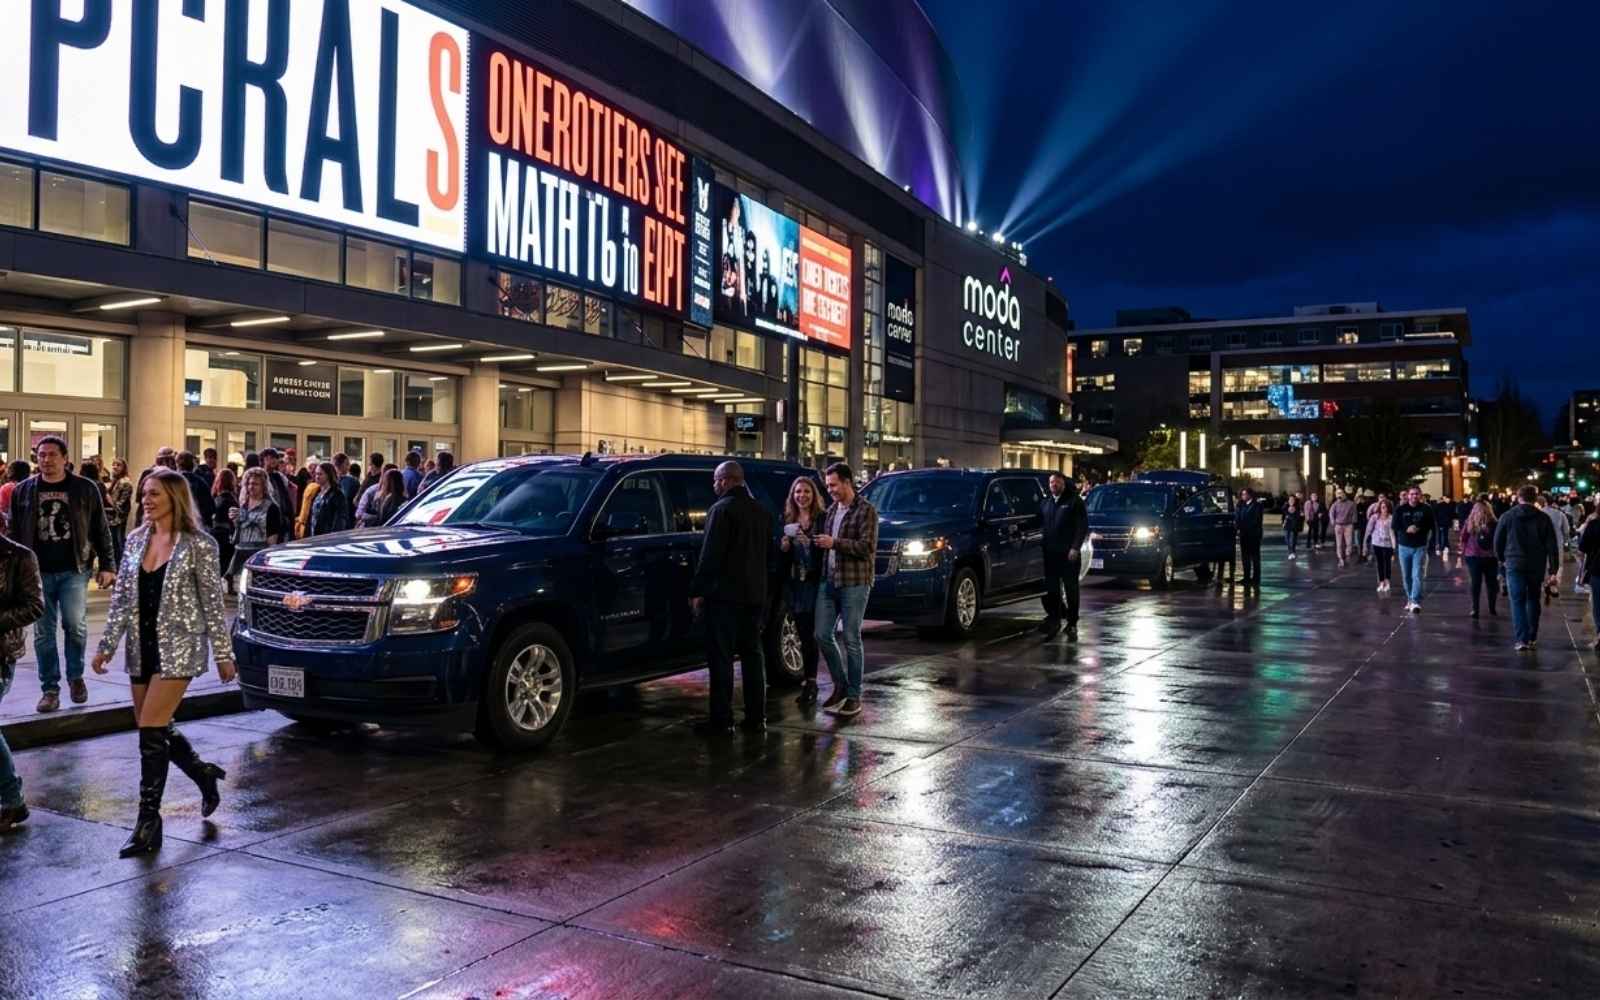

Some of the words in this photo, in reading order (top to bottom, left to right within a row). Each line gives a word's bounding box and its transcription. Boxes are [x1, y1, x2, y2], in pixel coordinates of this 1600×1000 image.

[489, 51, 650, 205] ONEROTIERS
[655, 138, 686, 225] SEE
[644, 215, 686, 312] EIPT
[963, 320, 1020, 362] center
[964, 275, 1020, 331] moda
